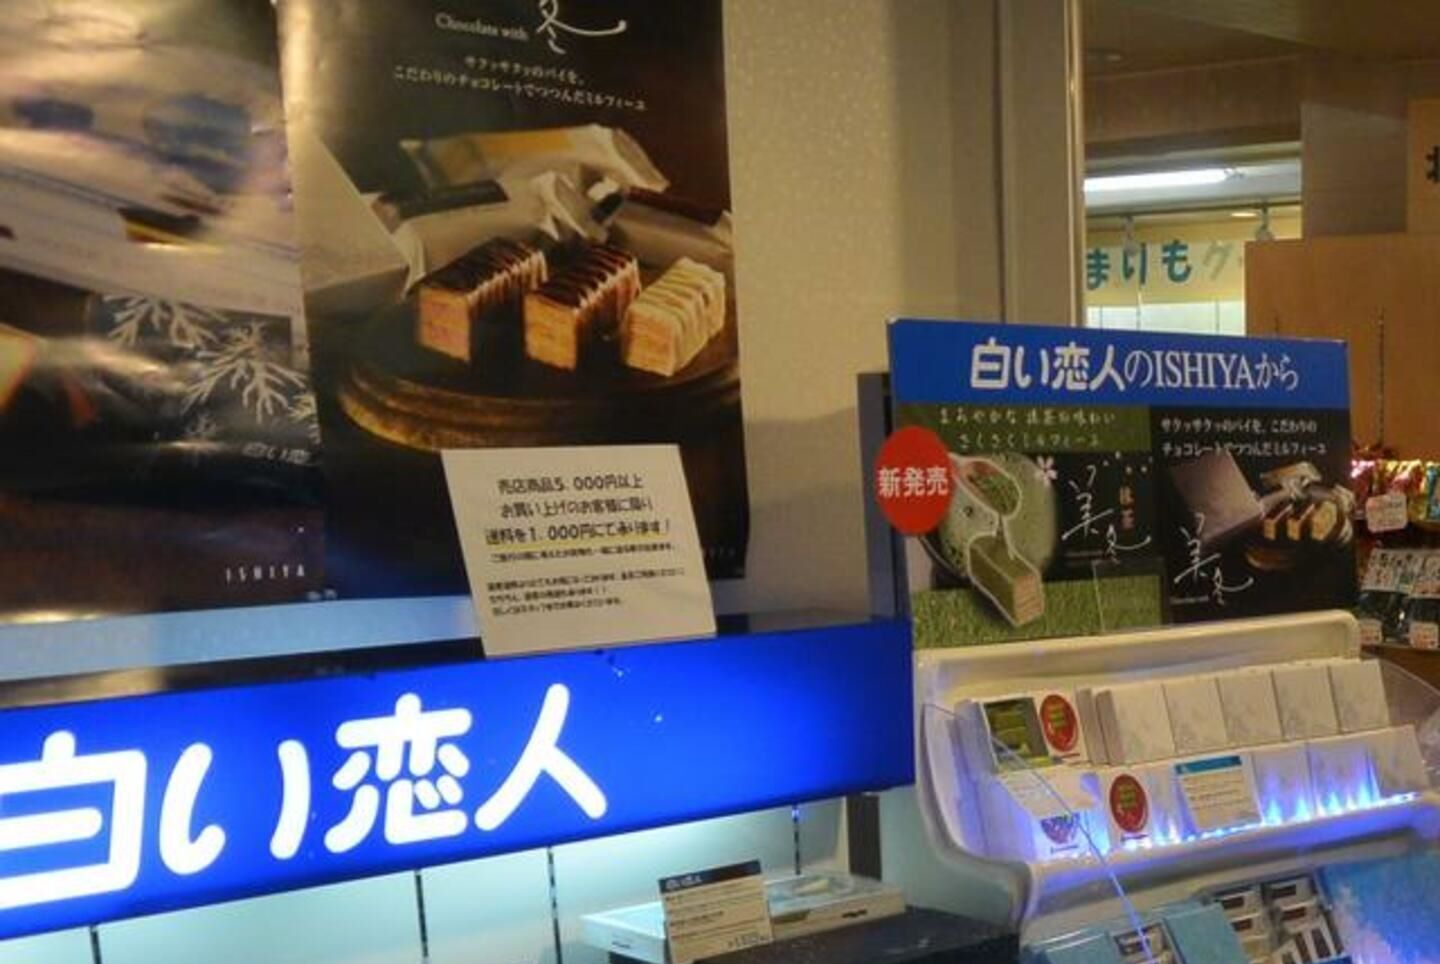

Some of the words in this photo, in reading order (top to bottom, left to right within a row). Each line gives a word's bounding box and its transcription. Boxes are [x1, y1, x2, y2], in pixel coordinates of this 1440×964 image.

[435, 12, 499, 38] Chocolate
[501, 24, 529, 42] with
[1086, 239, 1243, 291] まりもグ
[970, 336, 1300, 392] 白い恋人のISHIYAから
[878, 465, 949, 498] 新発売
[0, 682, 607, 910] 白い恋人
